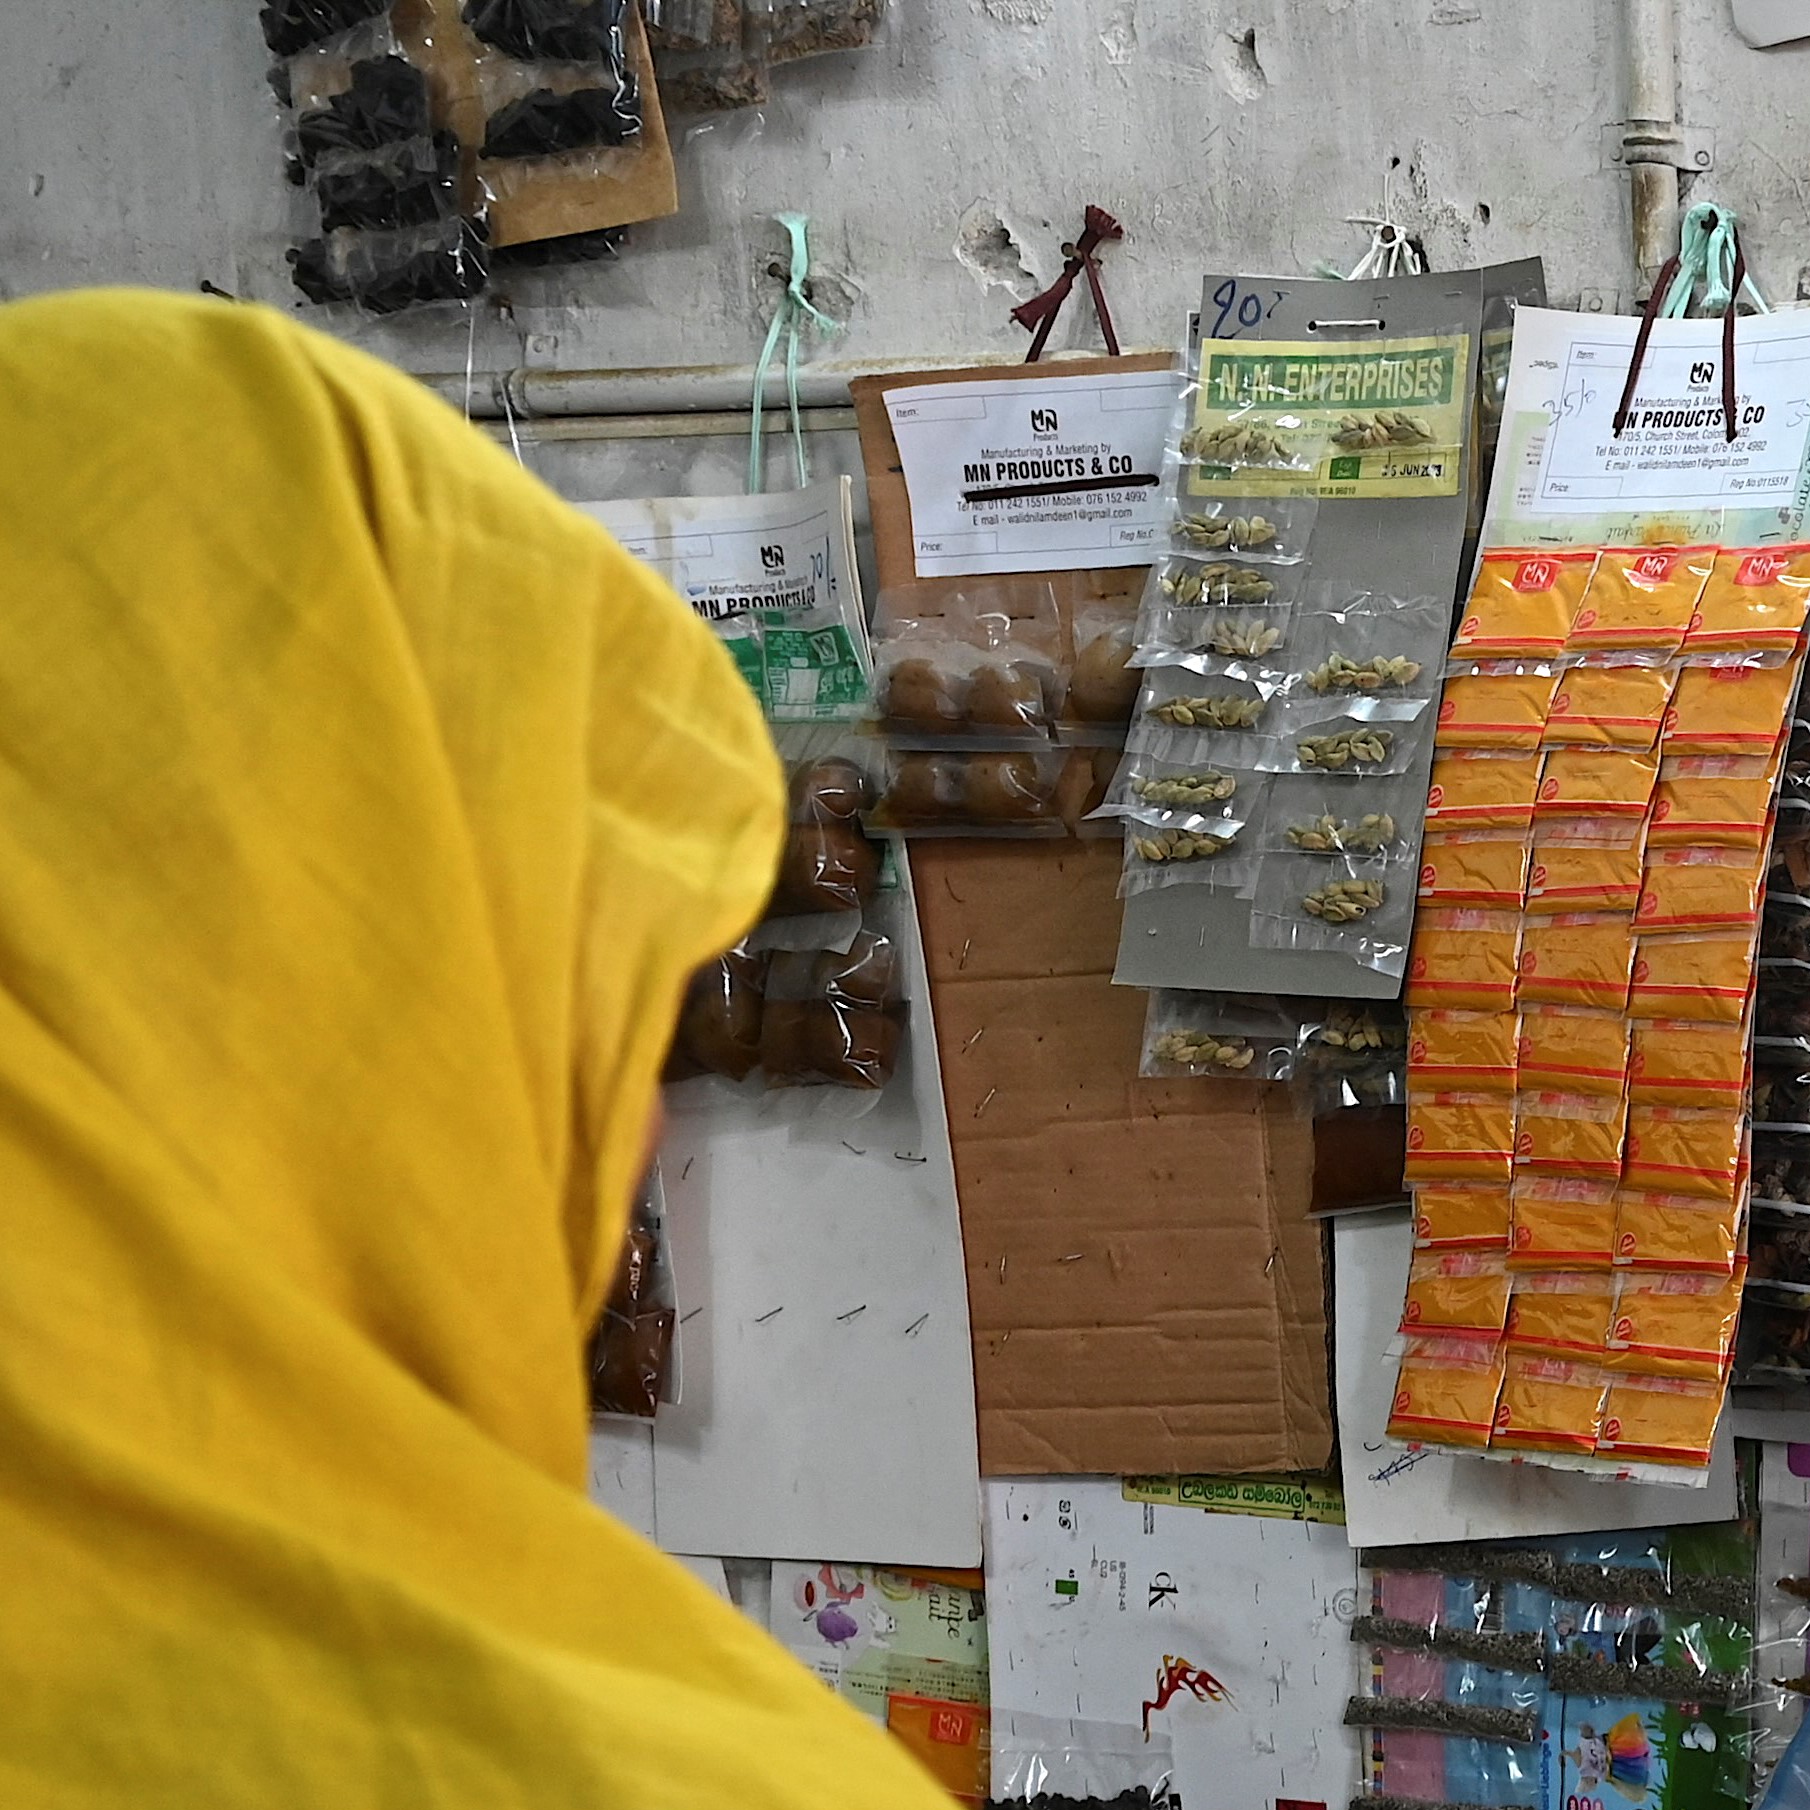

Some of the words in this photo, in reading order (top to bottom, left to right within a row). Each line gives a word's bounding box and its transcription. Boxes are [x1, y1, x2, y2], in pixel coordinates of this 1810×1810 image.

[1283, 357, 1444, 401] ENTERPRISES
[1635, 396, 1691, 409] Manufacturing
[1642, 409, 1722, 429] PRODUCTS
[1743, 405, 1764, 424] CO
[1645, 429, 1672, 441] Church
[981, 447, 1043, 460] Manufacturing
[1055, 445, 1098, 457] Marketing
[1624, 445, 1638, 456] 011
[1640, 444, 1657, 455] 242
[1683, 441, 1709, 454] Mobile:
[1730, 441, 1745, 452] 152
[964, 464, 990, 482] MN
[996, 457, 1085, 481] PRODUCTS
[1091, 457, 1102, 475] &
[1109, 455, 1133, 474] CO
[1400, 463, 1419, 475] JUN
[1731, 477, 1746, 489] Reg
[1006, 498, 1022, 510] 242
[1052, 495, 1084, 507] Mobile:
[1086, 494, 1105, 505] 076
[1106, 492, 1122, 504] 152
[1124, 490, 1147, 503] 4992
[981, 513, 999, 526] mail
[921, 541, 942, 551] Price:
[709, 581, 775, 596] Manufacturing
